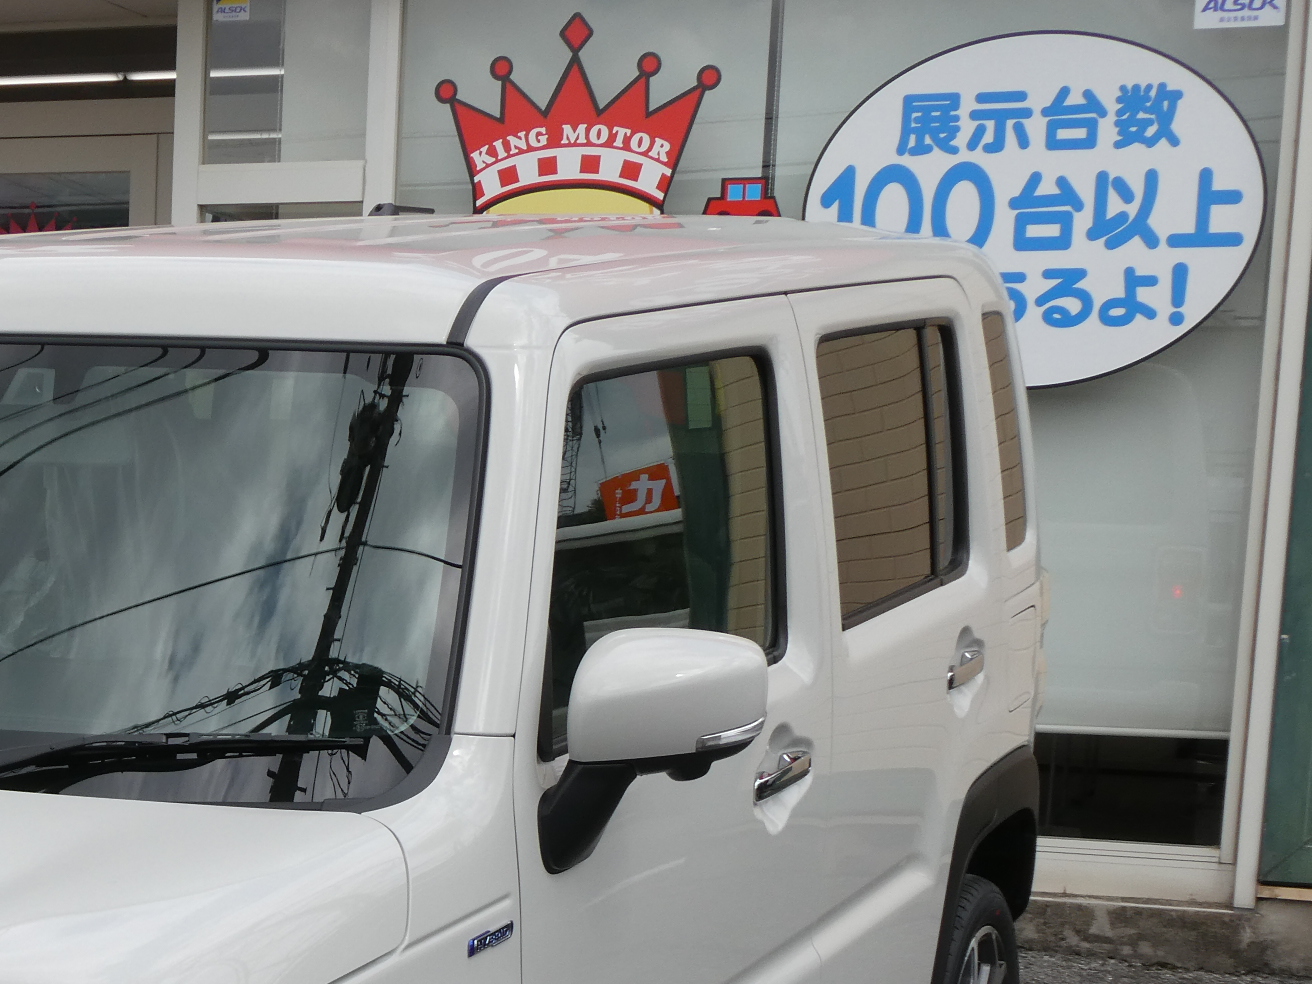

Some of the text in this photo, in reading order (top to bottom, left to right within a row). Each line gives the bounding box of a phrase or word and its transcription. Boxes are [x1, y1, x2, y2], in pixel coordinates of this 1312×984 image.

[470, 124, 672, 171] KING MOTOR
[896, 82, 1183, 157] 展示台数
[819, 160, 1244, 252] 100台以上
